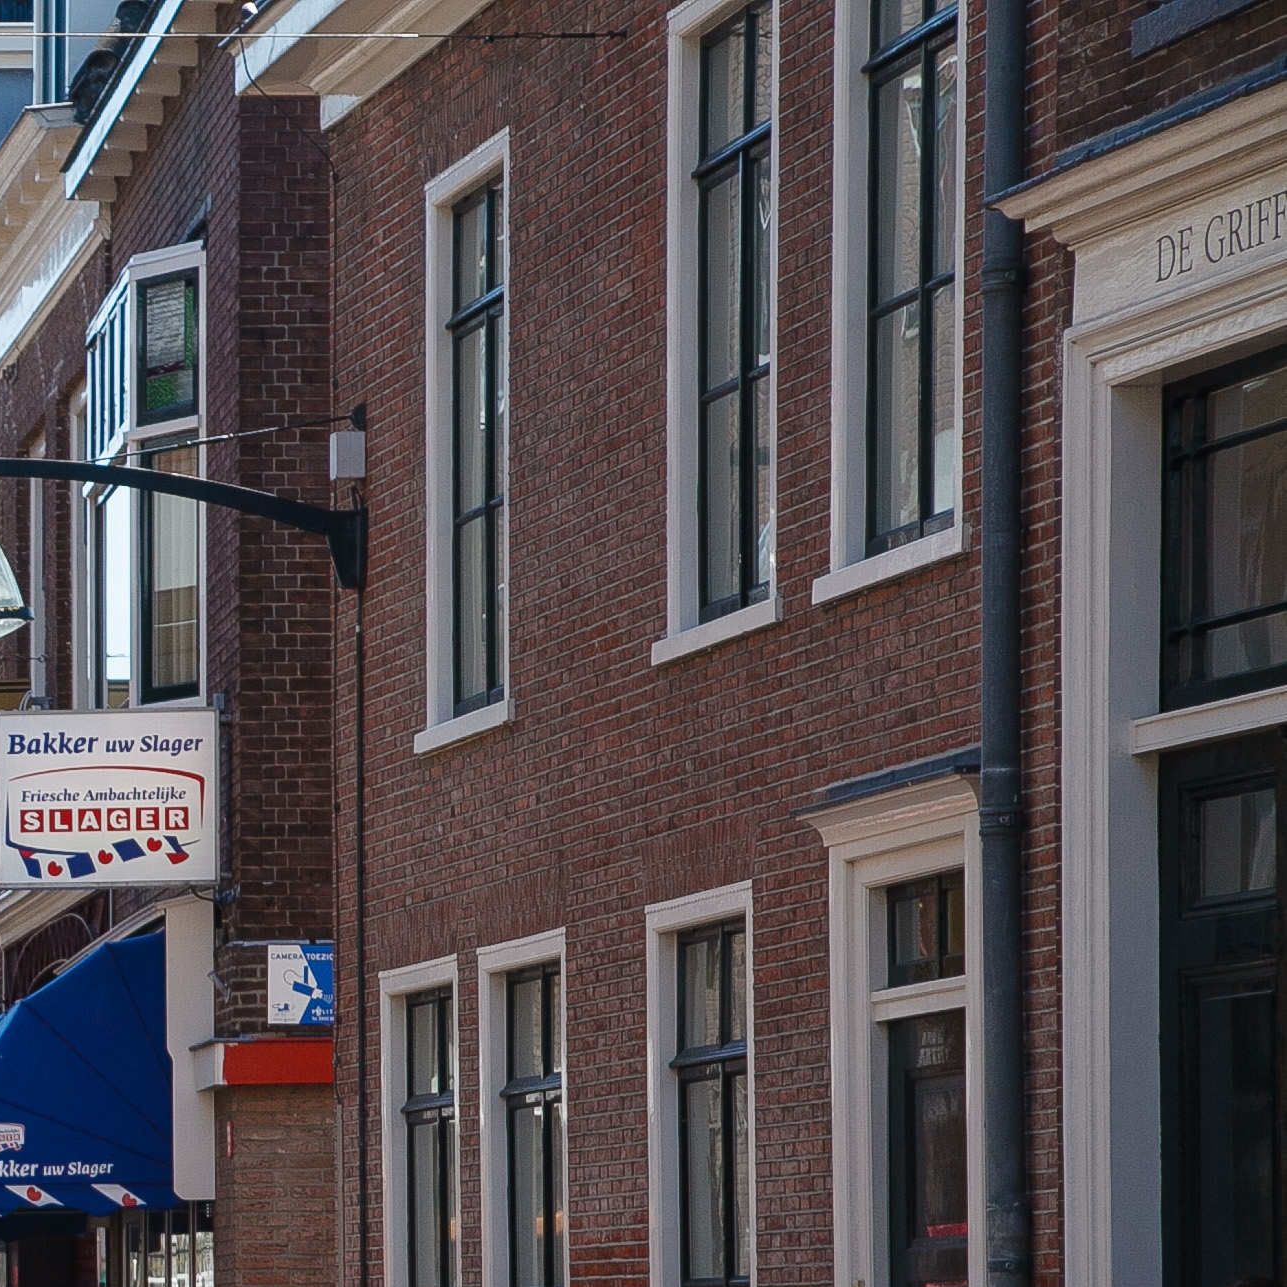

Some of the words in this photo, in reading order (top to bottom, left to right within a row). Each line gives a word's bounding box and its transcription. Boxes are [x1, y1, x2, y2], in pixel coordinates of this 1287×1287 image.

[1155, 226, 1194, 284] DE
[6, 731, 99, 756] Bakker
[105, 738, 135, 754] uw
[139, 734, 204, 757] Slager
[21, 787, 80, 803] Friesche
[82, 785, 187, 804] Ambachtelijke
[21, 807, 189, 832] SLAGER
[270, 952, 304, 961] CAMERA
[43, 1165, 65, 1176] uw
[67, 1161, 114, 1178] Slager
